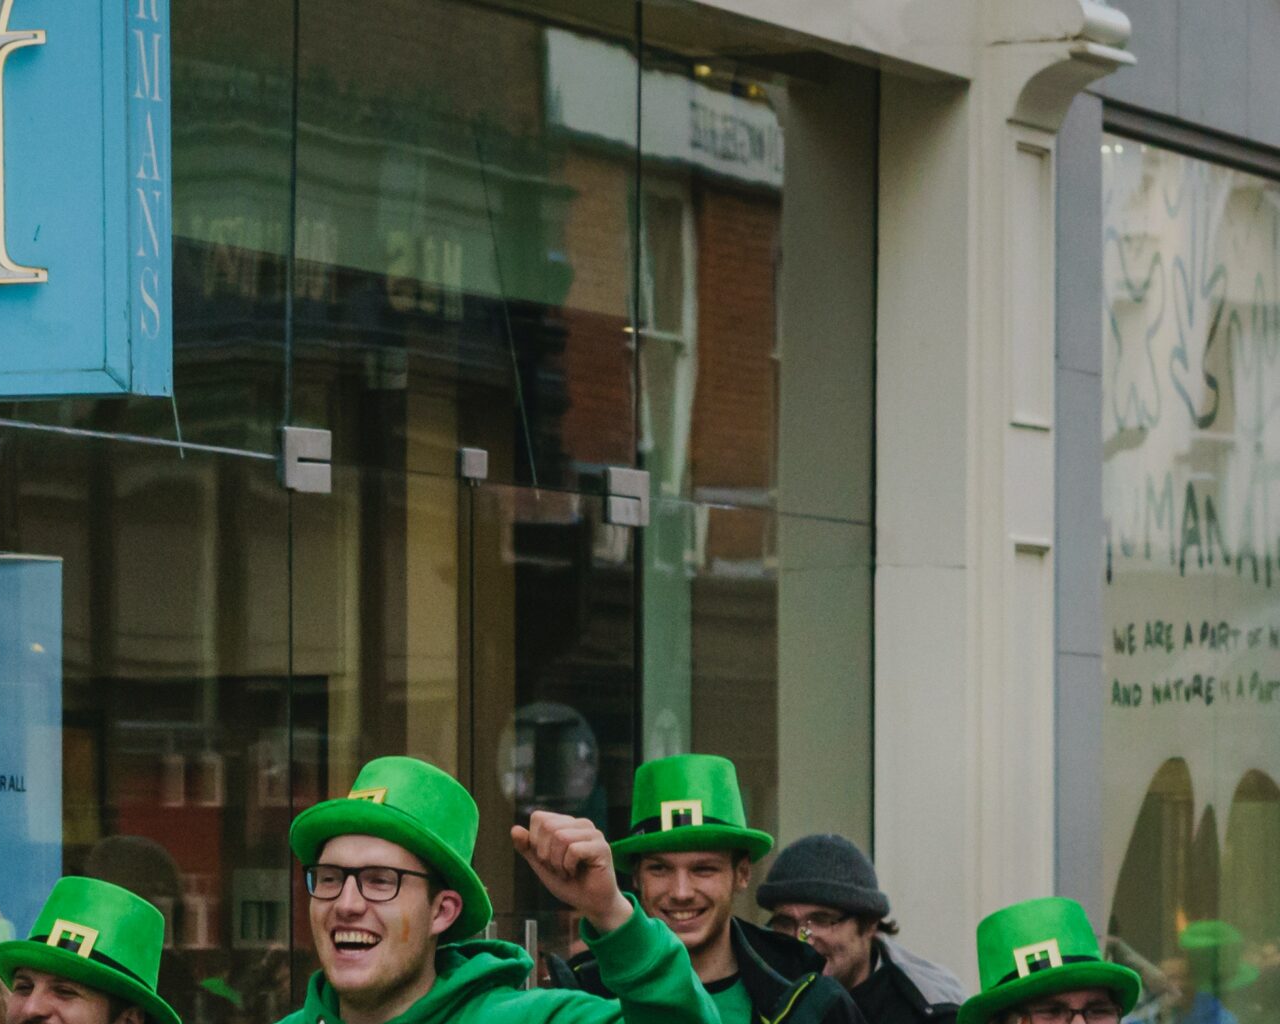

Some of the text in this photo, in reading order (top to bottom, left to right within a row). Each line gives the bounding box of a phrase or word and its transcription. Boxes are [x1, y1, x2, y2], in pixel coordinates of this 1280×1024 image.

[1144, 618, 1174, 654] ARE
[1183, 620, 1194, 650] A
[1111, 677, 1143, 708] AND
[1151, 672, 1216, 708] NATURE
[9, 775, 27, 792] ALL
